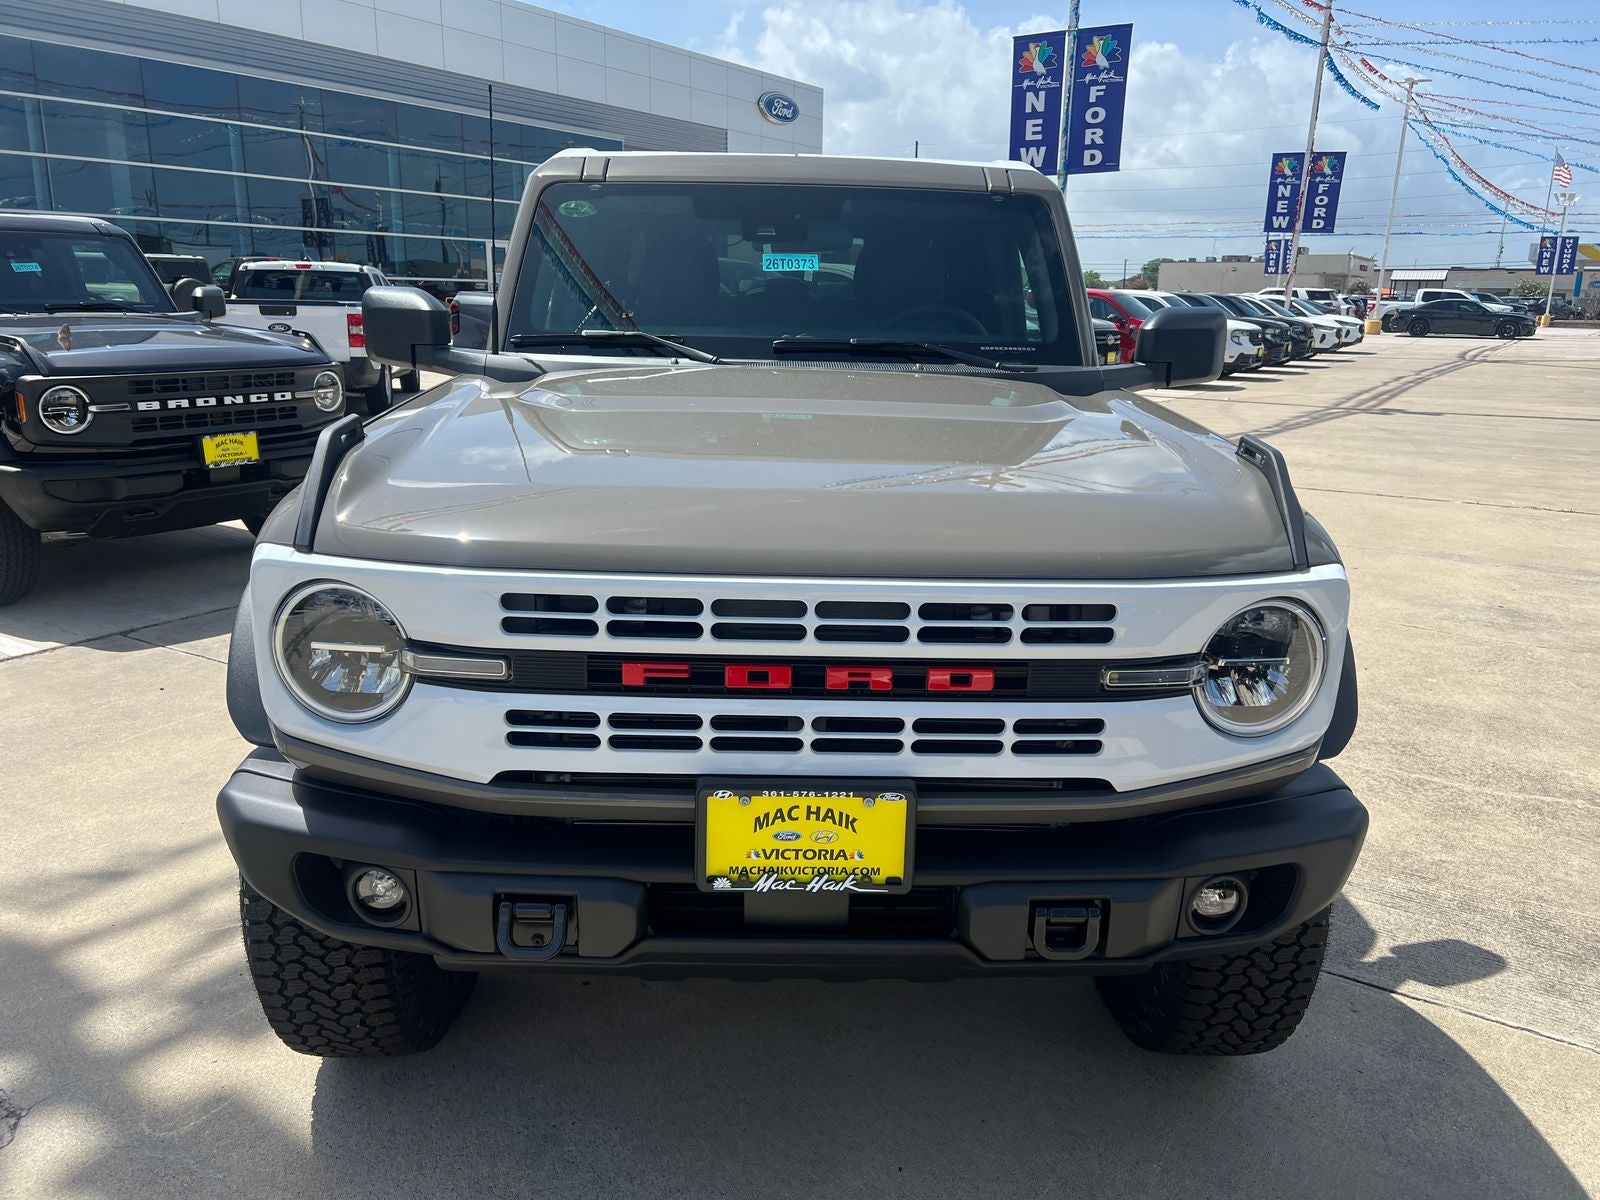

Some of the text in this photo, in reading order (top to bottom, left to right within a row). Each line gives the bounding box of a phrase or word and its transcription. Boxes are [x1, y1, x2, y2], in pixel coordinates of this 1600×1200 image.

[771, 98, 794, 118] Ford
[1020, 91, 1047, 168] NEW
[1083, 85, 1106, 166] FORD
[1272, 185, 1291, 228] NEW
[1312, 184, 1329, 229] FORD
[765, 258, 815, 270] 26T0373
[1267, 253, 1276, 273] NEW
[1540, 252, 1550, 273] NEW
[1562, 239, 1573, 273] HYUNDAI
[137, 391, 292, 411] BRONCO
[622, 662, 994, 691] FORD
[762, 790, 854, 798] 361-576-1221
[753, 805, 858, 834] MAC HAIK
[777, 832, 797, 840] Ford
[761, 848, 849, 861] VICTORIA
[728, 865, 881, 875] MACHAIKVICTORIA.COM
[752, 873, 862, 893] Mac Haik
